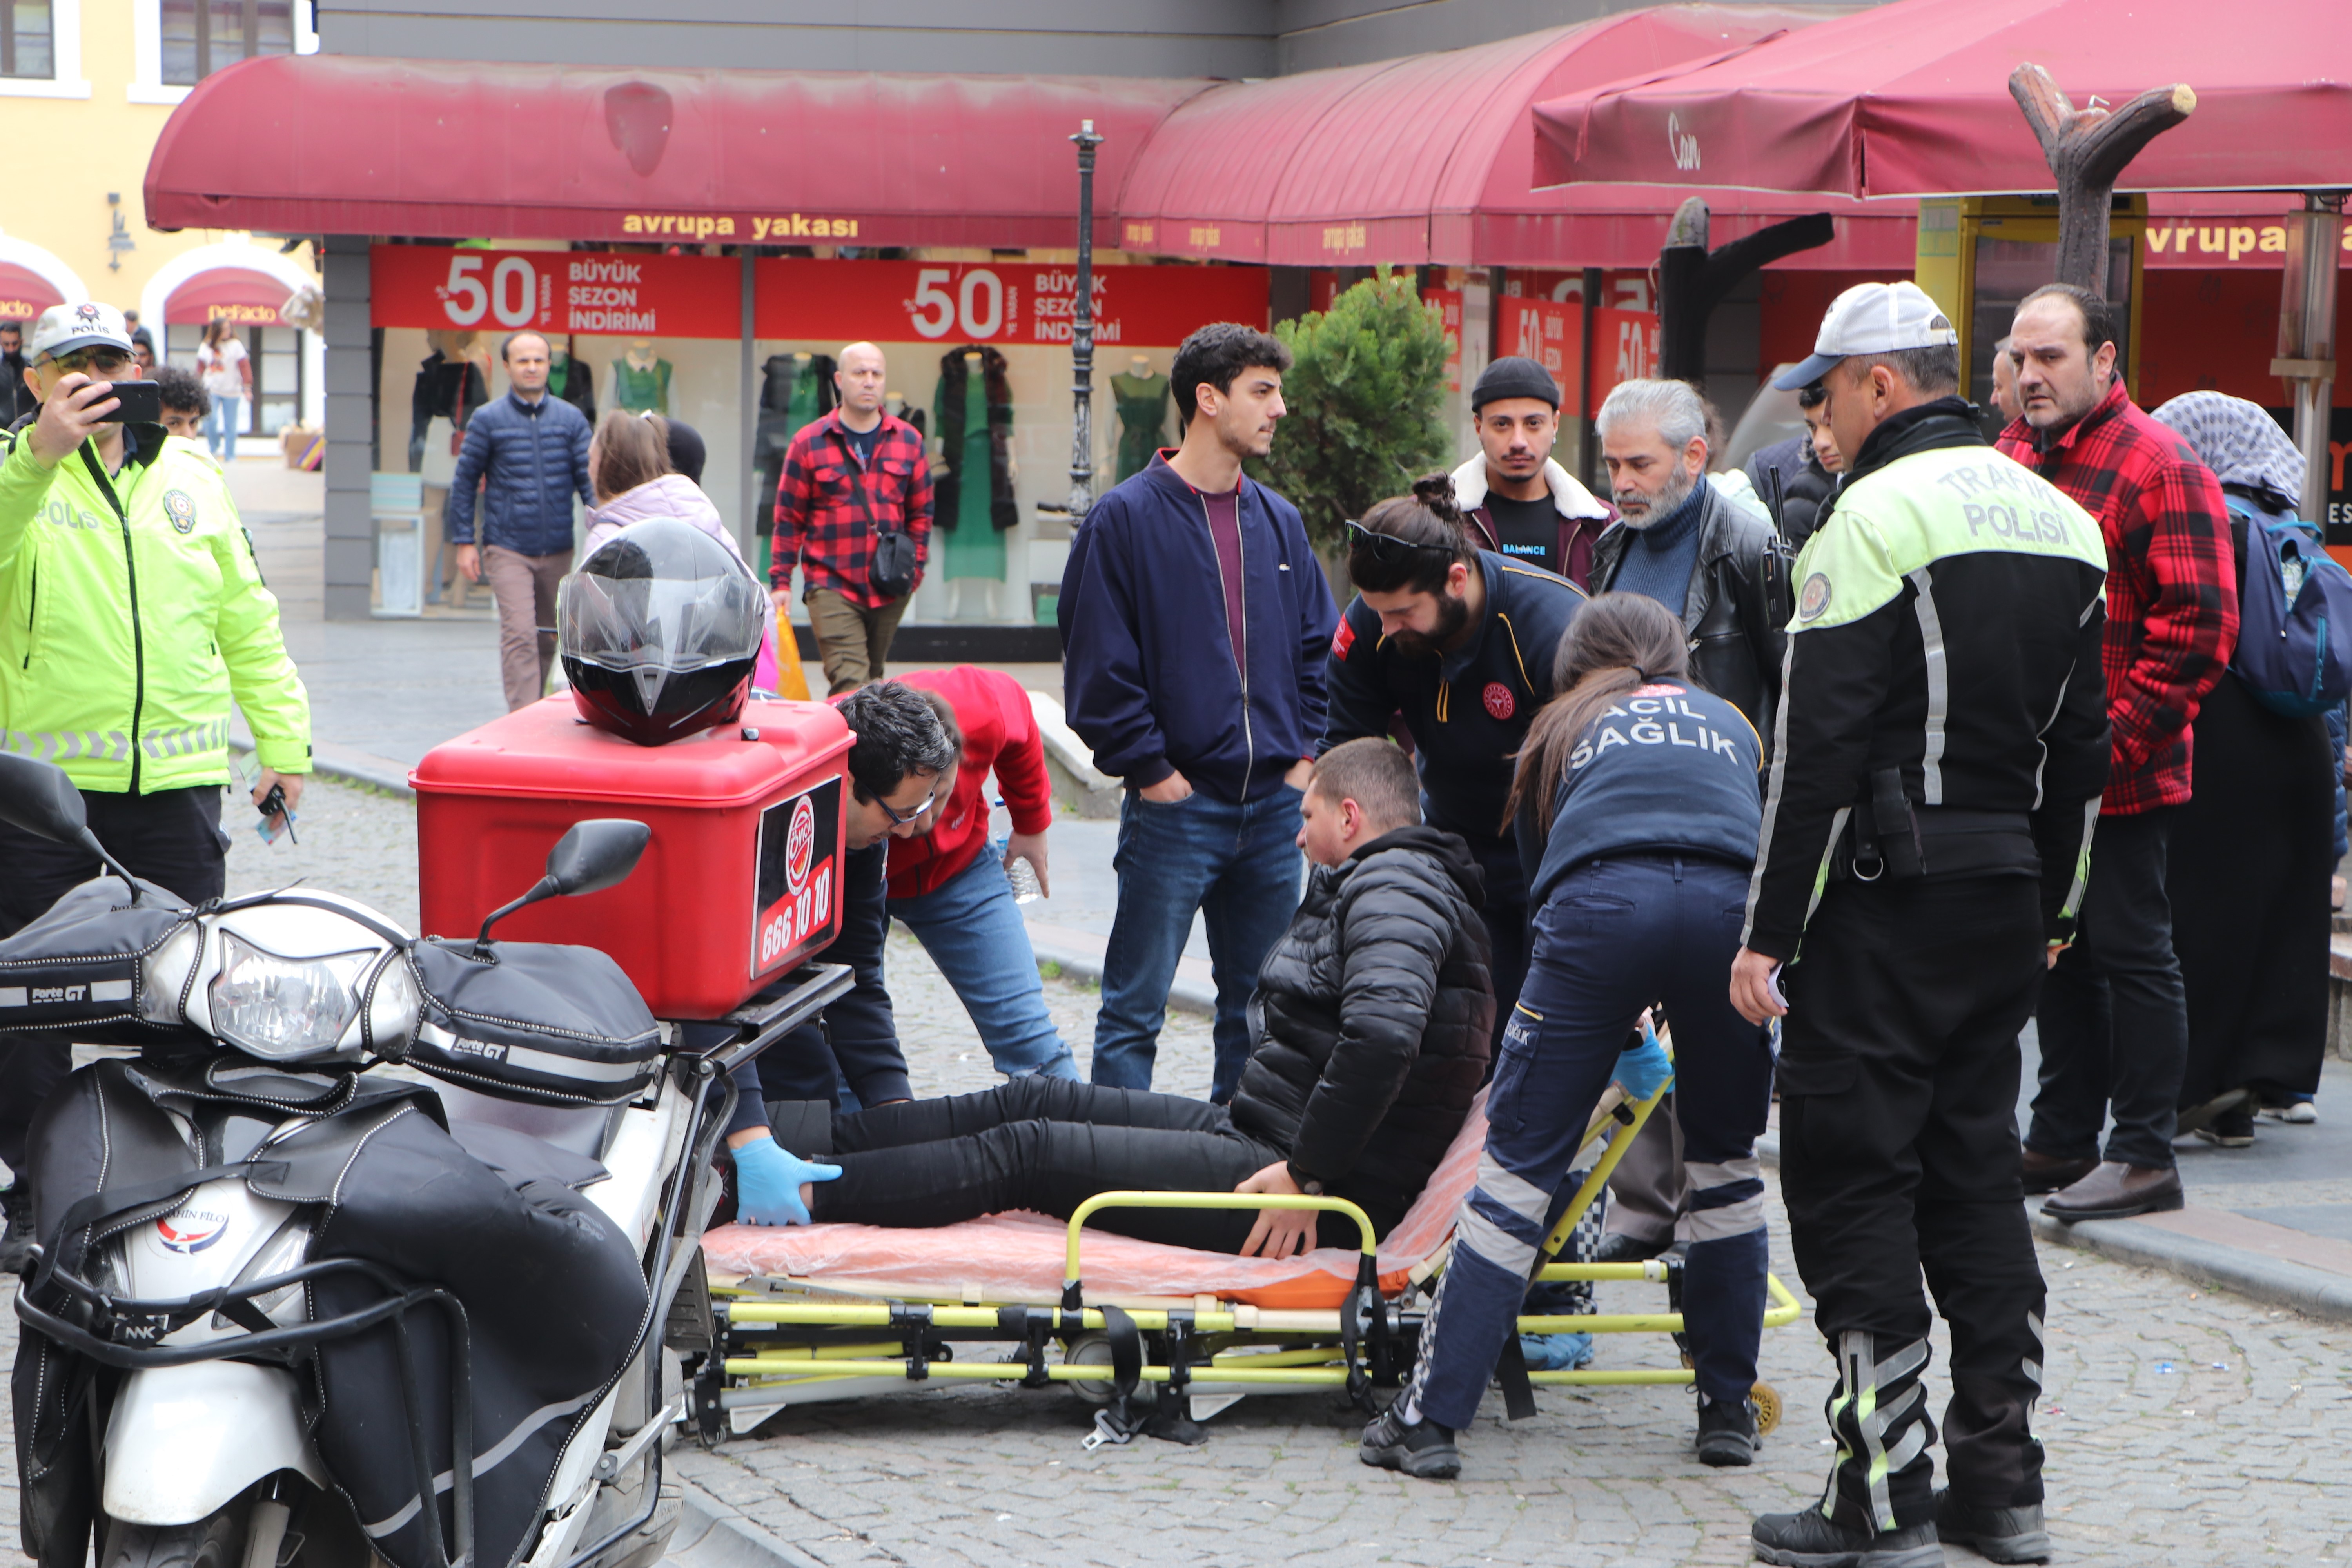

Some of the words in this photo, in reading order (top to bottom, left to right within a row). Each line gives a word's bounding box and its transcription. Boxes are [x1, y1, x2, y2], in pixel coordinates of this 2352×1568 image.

[623, 214, 735, 240] avrupa
[752, 213, 858, 240] yakası
[2145, 226, 2287, 261] vrupa
[569, 259, 641, 283] BÜYÜK
[1035, 270, 1107, 293] BÜYK
[568, 286, 637, 307] SEZON
[569, 307, 656, 332] İNDİRİMİ
[1503, 544, 1545, 555] BALANCE
[1570, 716, 1738, 770] SAĞLIK
[762, 905, 793, 962] 666
[795, 886, 811, 941] 10
[814, 866, 830, 926] 10
[32, 987, 64, 1000] Forte
[65, 985, 86, 1001] GT
[483, 1043, 506, 1060] GT
